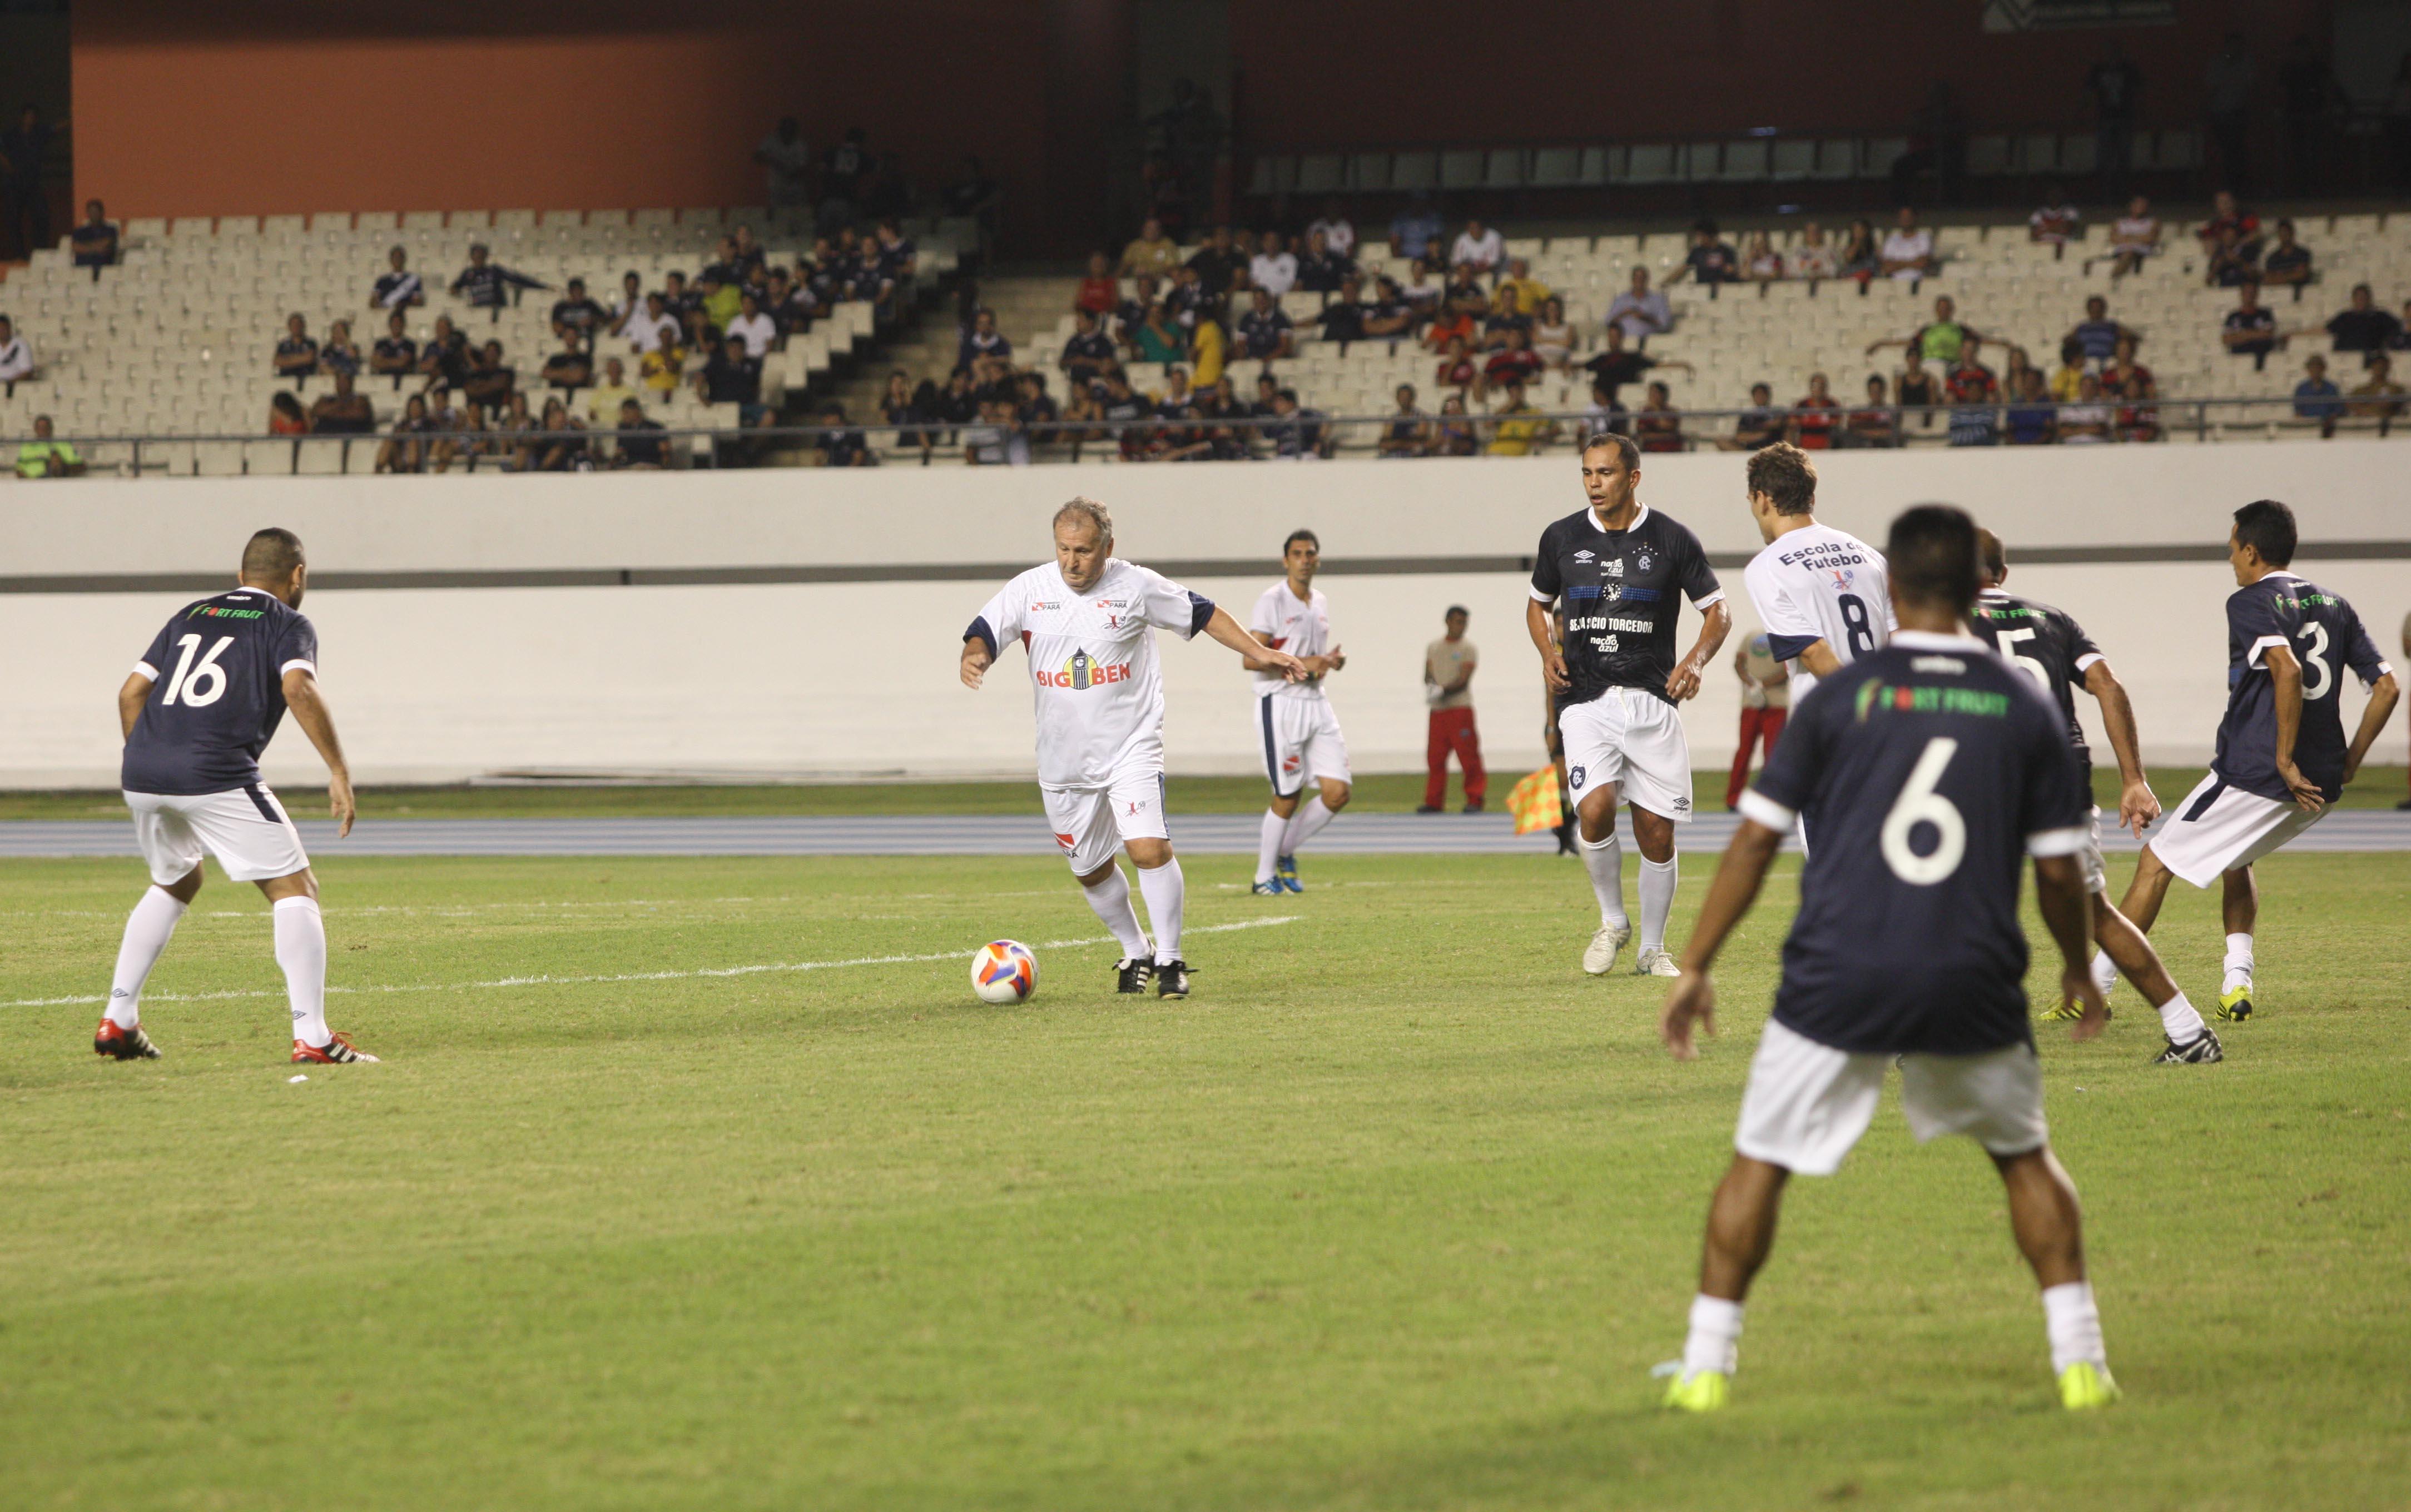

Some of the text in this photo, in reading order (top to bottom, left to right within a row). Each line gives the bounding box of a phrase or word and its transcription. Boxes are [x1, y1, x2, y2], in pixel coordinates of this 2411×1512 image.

[1778, 541, 1842, 566] Escola
[1802, 553, 1868, 571] Futebol
[230, 609, 265, 619] FRUIT
[1609, 618, 1654, 633] TORCEDOR
[1838, 594, 1875, 662] 8
[1598, 644, 1619, 652] azul
[2296, 621, 2332, 700] 3
[162, 634, 235, 707] 16
[1996, 628, 2051, 695] 5
[1036, 662, 1131, 688] BIG BEN
[1881, 737, 1967, 886] 6
